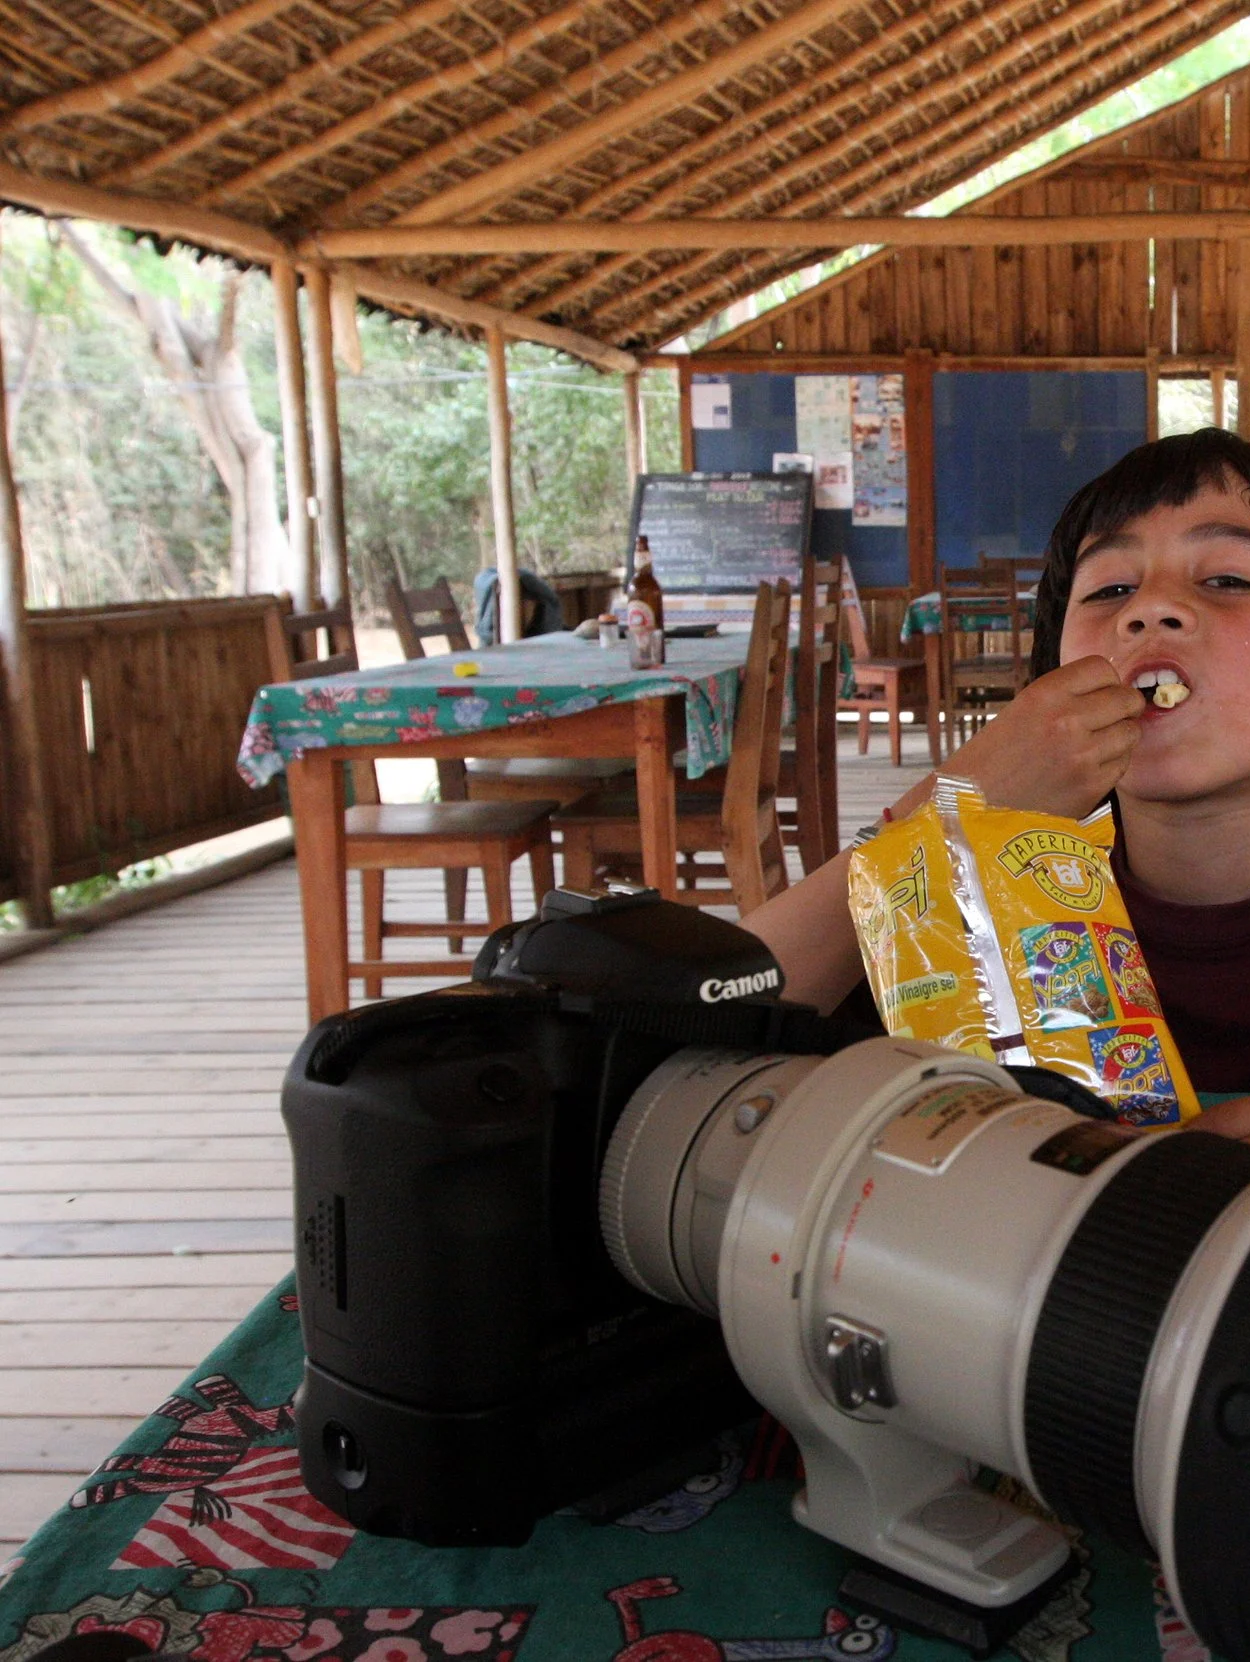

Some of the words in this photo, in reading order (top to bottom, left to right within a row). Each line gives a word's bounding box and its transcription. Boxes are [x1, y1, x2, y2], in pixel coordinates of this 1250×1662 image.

[1014, 834, 1100, 861] APERITIF
[699, 968, 779, 1004] Canon
[898, 980, 938, 1002] Vinaigre
